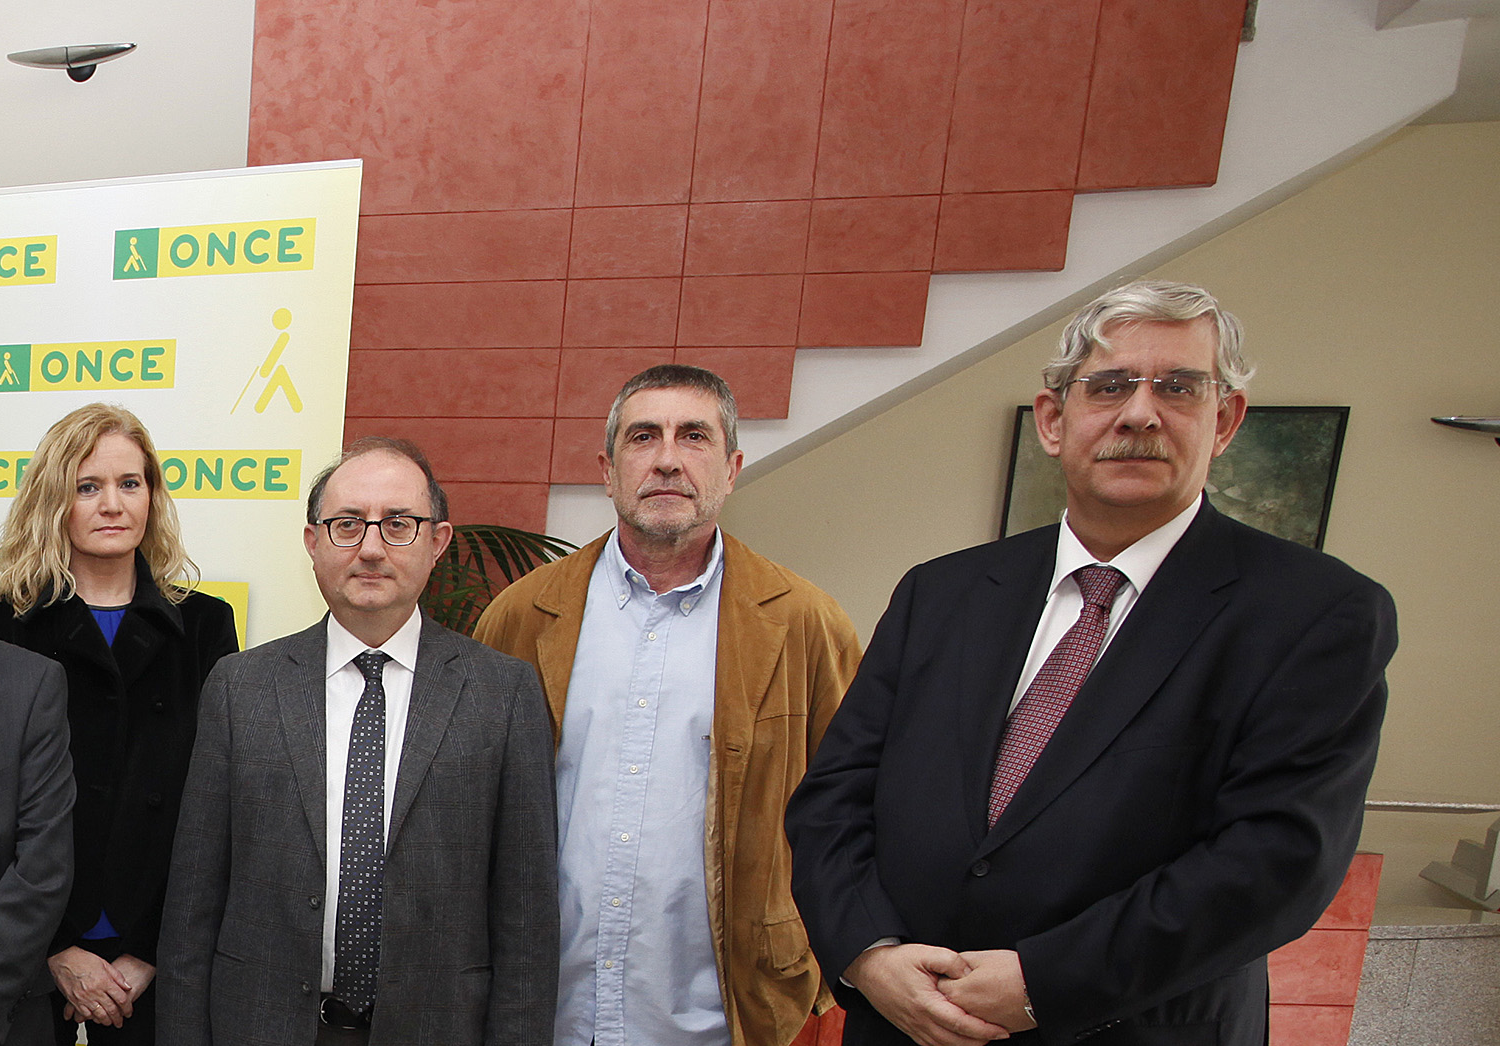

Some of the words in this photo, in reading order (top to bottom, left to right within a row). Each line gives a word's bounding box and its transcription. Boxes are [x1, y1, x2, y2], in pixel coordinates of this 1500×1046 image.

[170, 226, 304, 268] ONCE
[42, 347, 165, 383] ONCE
[160, 457, 290, 491] ONCE
